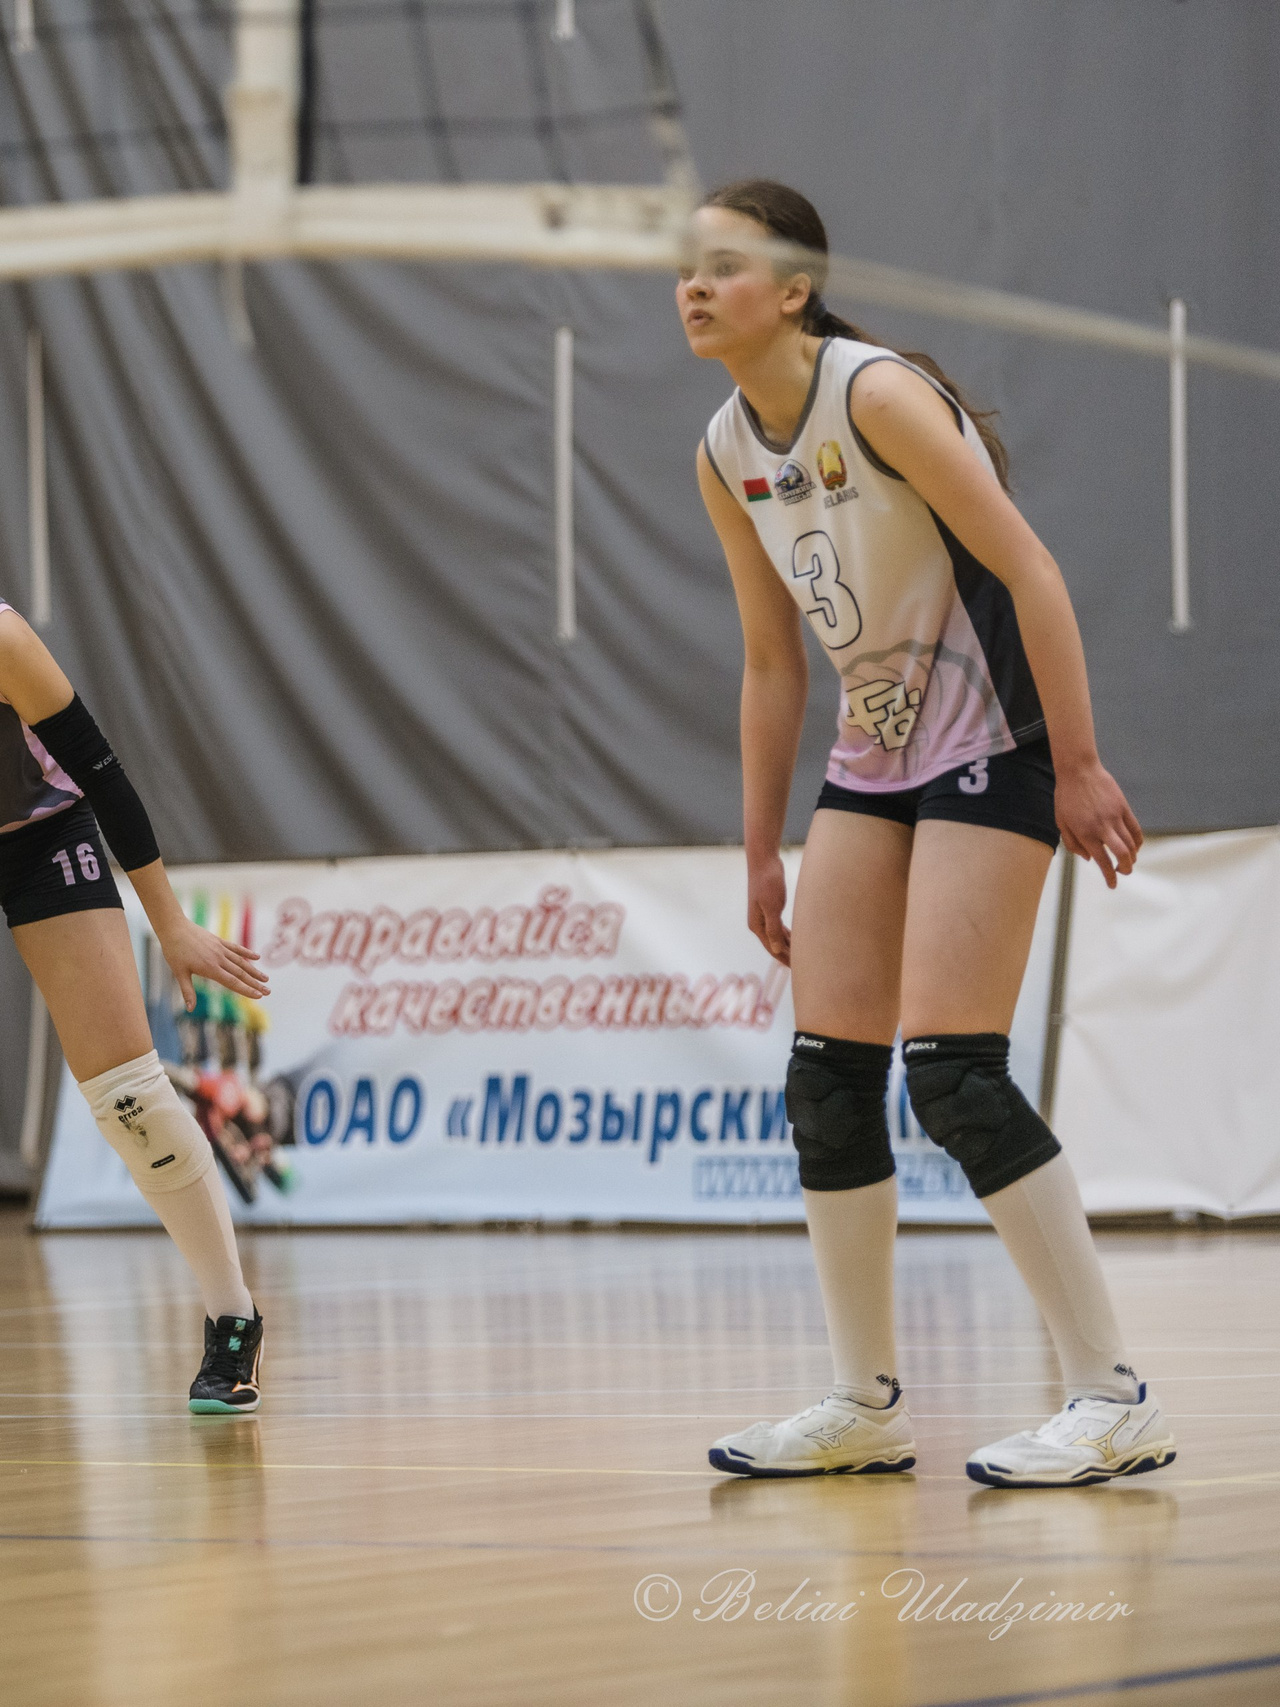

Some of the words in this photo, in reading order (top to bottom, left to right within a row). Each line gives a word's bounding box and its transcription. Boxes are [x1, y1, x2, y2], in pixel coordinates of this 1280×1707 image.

[793, 530, 862, 650] 3
[958, 757, 989, 793] 3
[51, 842, 101, 886] 16
[265, 885, 624, 976] Заправляйся
[331, 963, 789, 1037] качественным!
[304, 1077, 423, 1147] ОАО
[446, 1075, 787, 1163] «Мозырски
